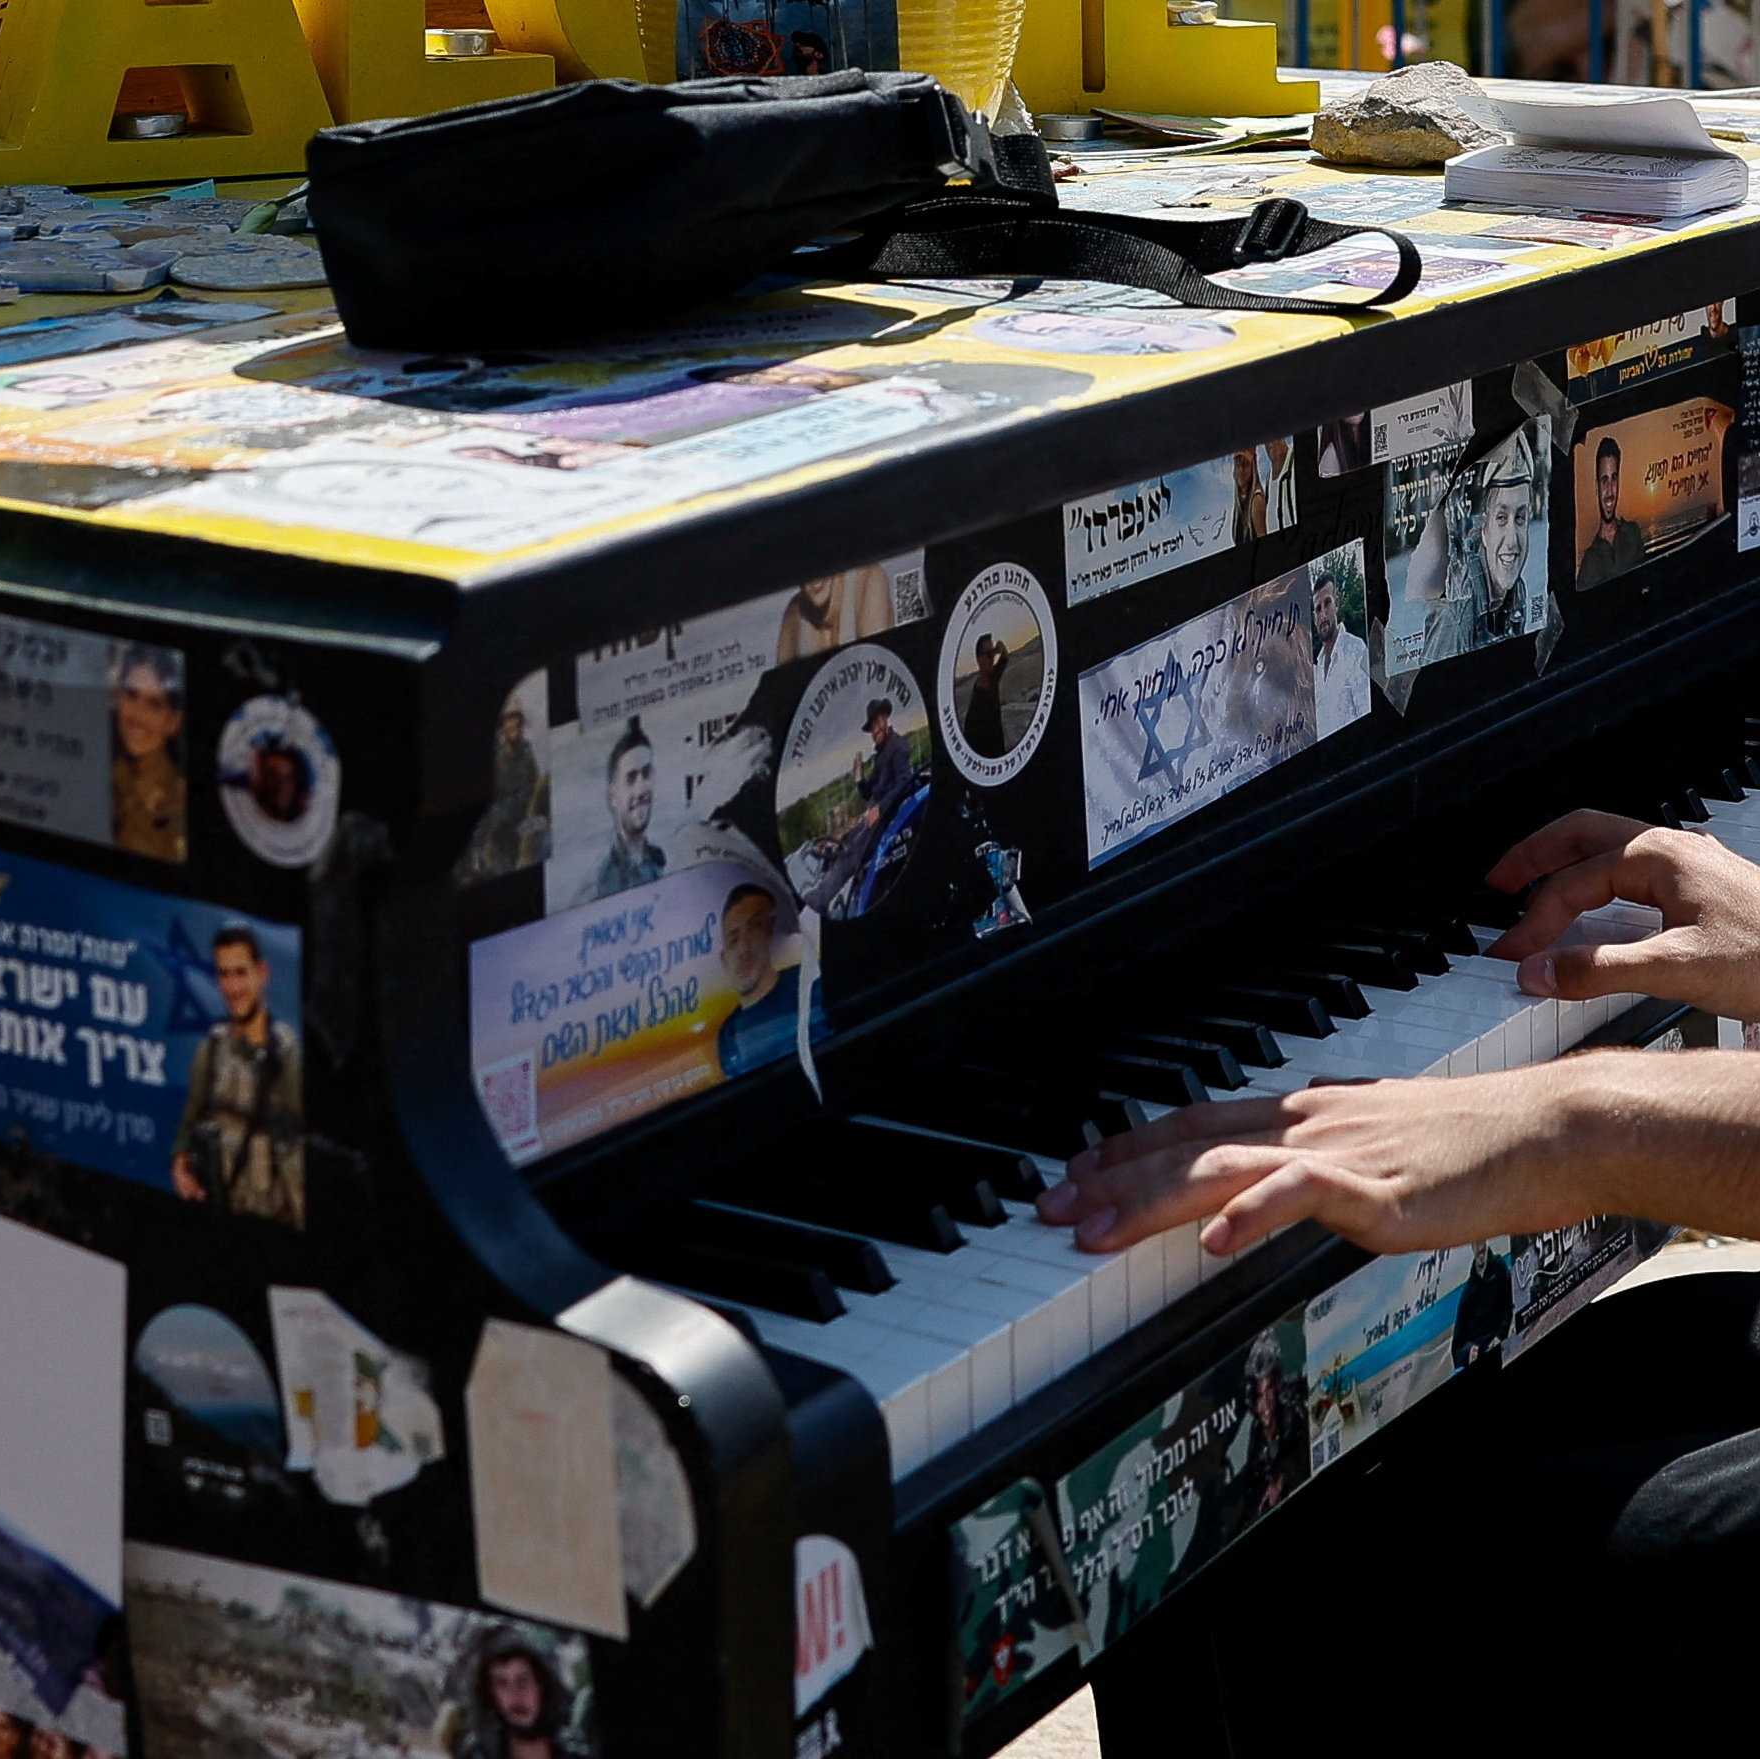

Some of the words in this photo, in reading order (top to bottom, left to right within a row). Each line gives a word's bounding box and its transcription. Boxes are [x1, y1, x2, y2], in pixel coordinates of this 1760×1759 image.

[1391, 456, 1411, 474] גשר
[1412, 449, 1431, 468] כולו
[1147, 474, 1174, 525] לא
[1391, 477, 1431, 509] והעיקר
[1393, 510, 1418, 537] כלל
[1004, 568, 1032, 592] תהנו
[865, 658, 887, 685] שלך
[885, 668, 913, 709] החיוך
[88, 971, 149, 1027] עם
[73, 1026, 168, 1088] צריך
[1212, 1398, 1237, 1435] אני
[1191, 1418, 1210, 1455] זה
[1108, 1482, 1131, 1517] זה
[1080, 1499, 1105, 1543] אף
[977, 1542, 1012, 1585] דבר
